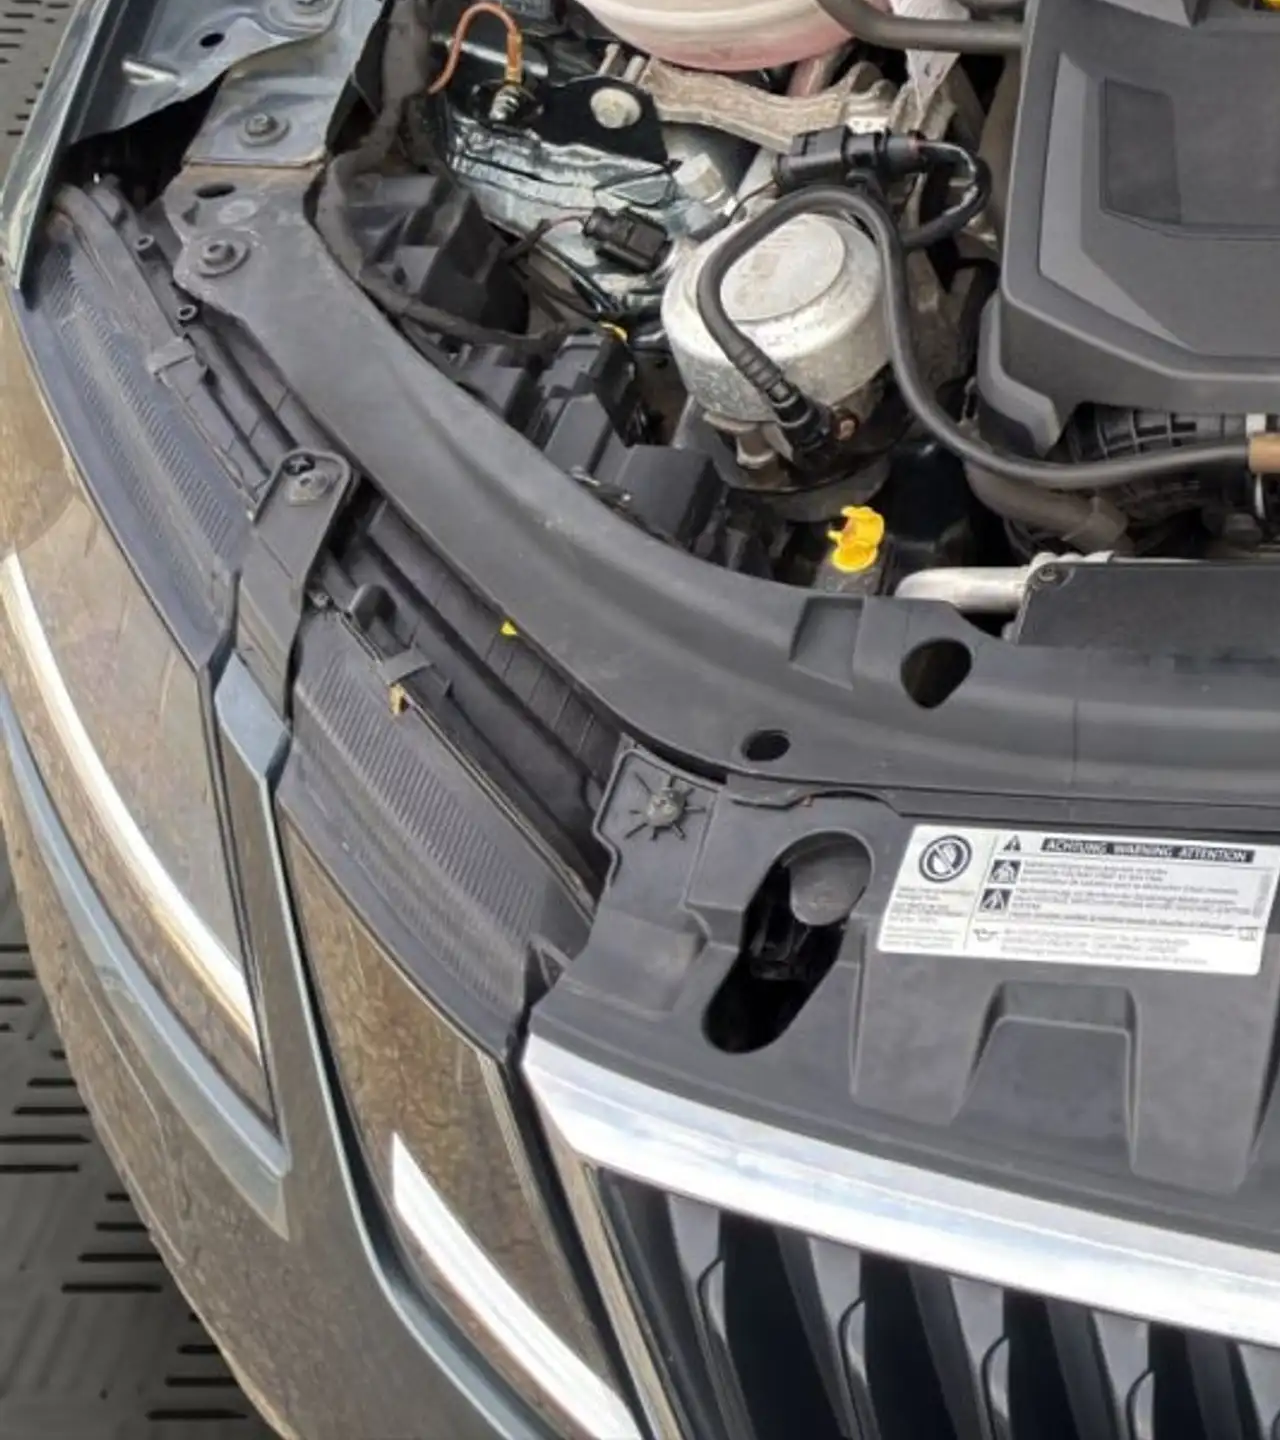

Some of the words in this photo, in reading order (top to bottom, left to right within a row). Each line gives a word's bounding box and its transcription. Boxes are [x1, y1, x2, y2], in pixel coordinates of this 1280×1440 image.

[1046, 839, 1107, 855] ACHTUNG
[1113, 843, 1173, 858] WARNING
[1178, 847, 1248, 862] ATTENTION
